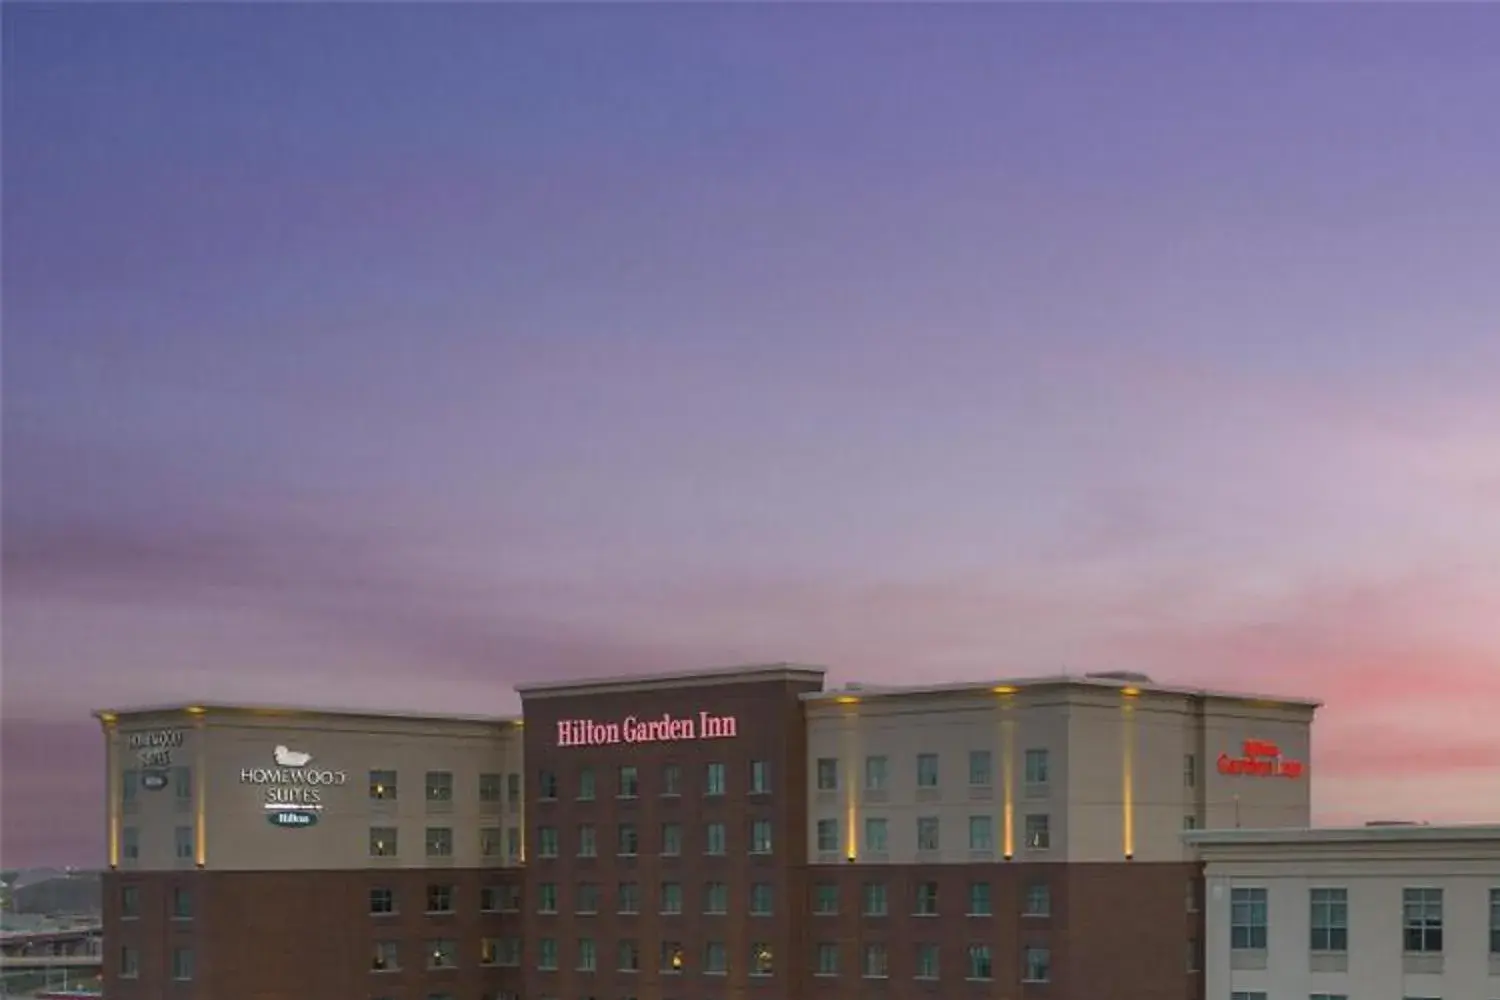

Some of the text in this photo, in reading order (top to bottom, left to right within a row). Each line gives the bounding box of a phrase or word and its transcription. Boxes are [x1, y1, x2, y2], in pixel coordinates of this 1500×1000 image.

[556, 711, 737, 747] Hilton Garden Inn
[240, 767, 346, 785] HOMEWOOD
[266, 786, 321, 803] SUITES
